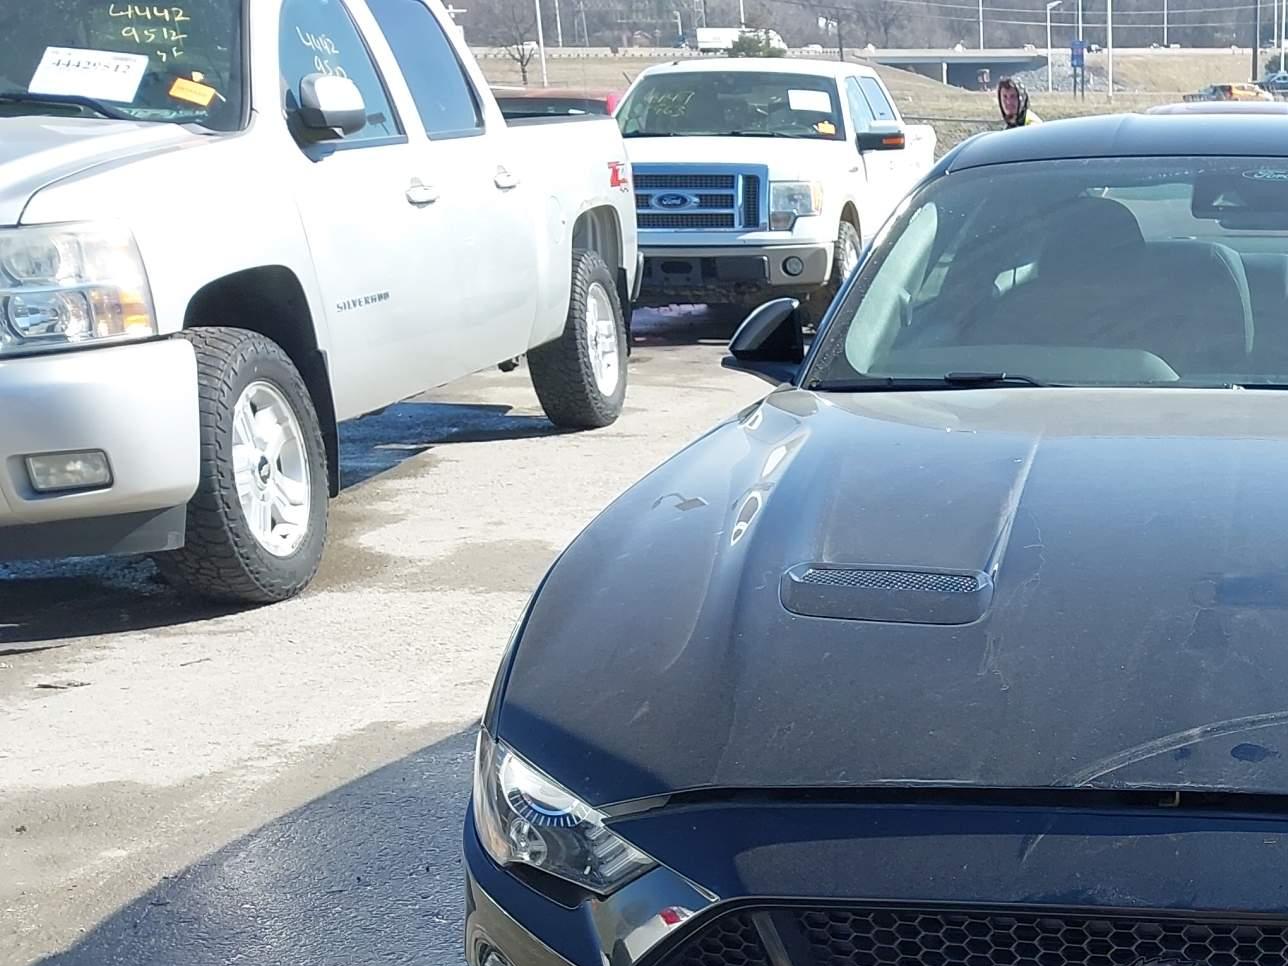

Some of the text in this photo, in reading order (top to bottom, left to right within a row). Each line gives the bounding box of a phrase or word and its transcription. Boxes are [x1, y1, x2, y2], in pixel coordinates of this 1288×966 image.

[109, 3, 191, 21] 4442
[121, 26, 188, 43] 9512
[295, 25, 340, 54] 4442
[336, 291, 390, 313] SILVERADO
